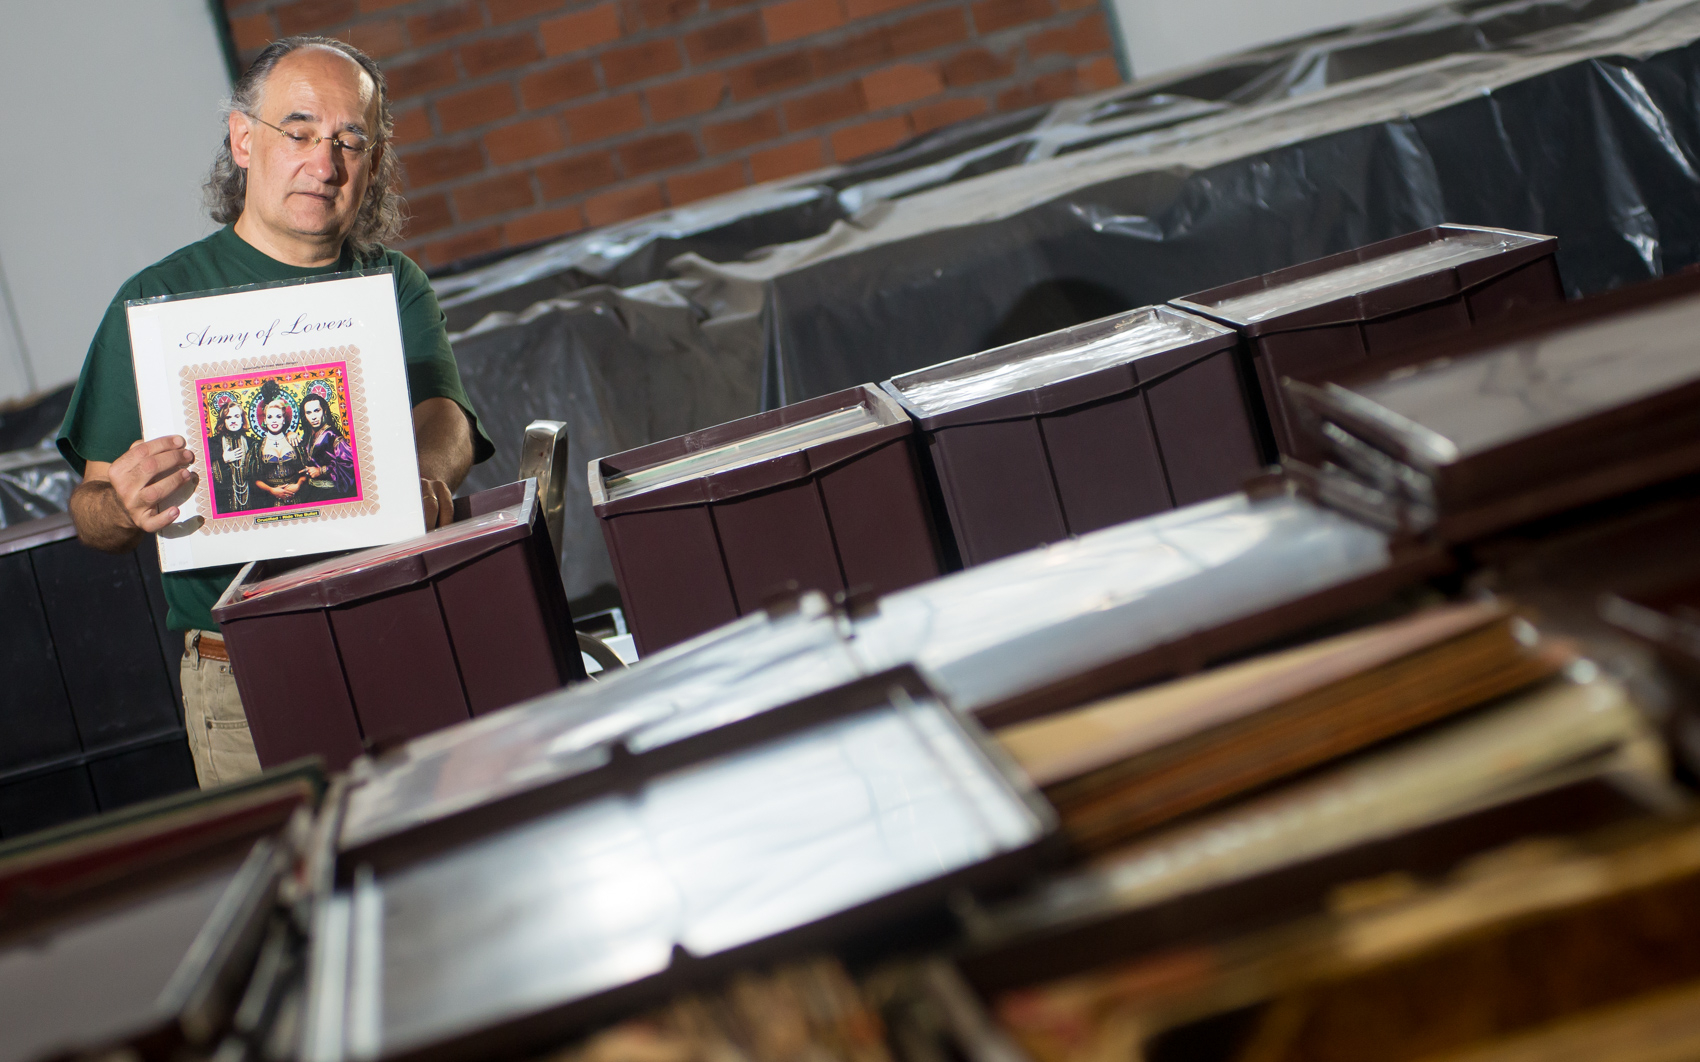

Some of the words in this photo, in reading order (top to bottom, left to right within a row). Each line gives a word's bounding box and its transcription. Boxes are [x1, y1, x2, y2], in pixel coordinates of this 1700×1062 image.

[179, 325, 250, 350] Army
[255, 318, 280, 346] of
[281, 312, 355, 336] Lovers
